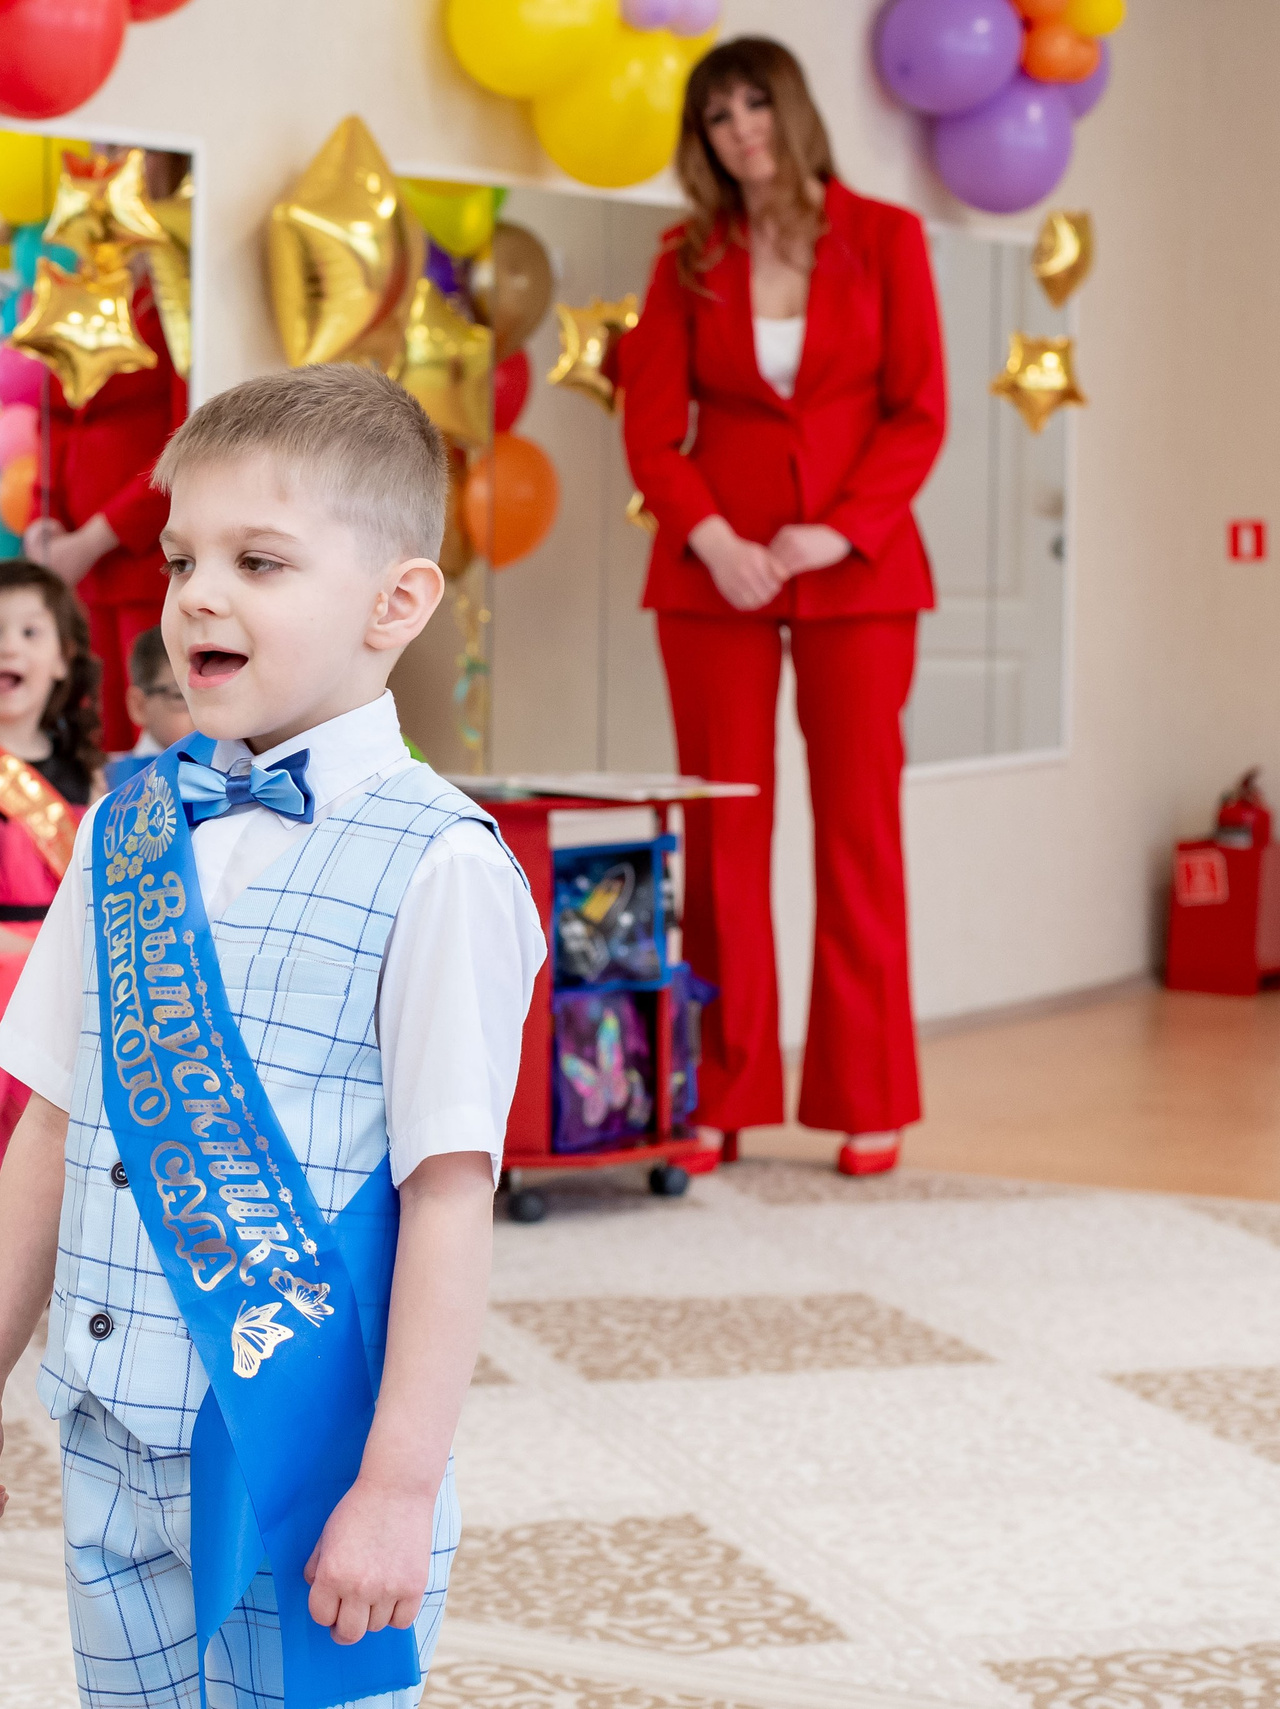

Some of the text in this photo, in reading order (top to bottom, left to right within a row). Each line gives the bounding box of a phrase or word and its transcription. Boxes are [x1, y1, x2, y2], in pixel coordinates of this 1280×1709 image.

[102, 891, 238, 1292] ДЕТСКОГО САДА
[138, 871, 300, 1286] Выпускник
